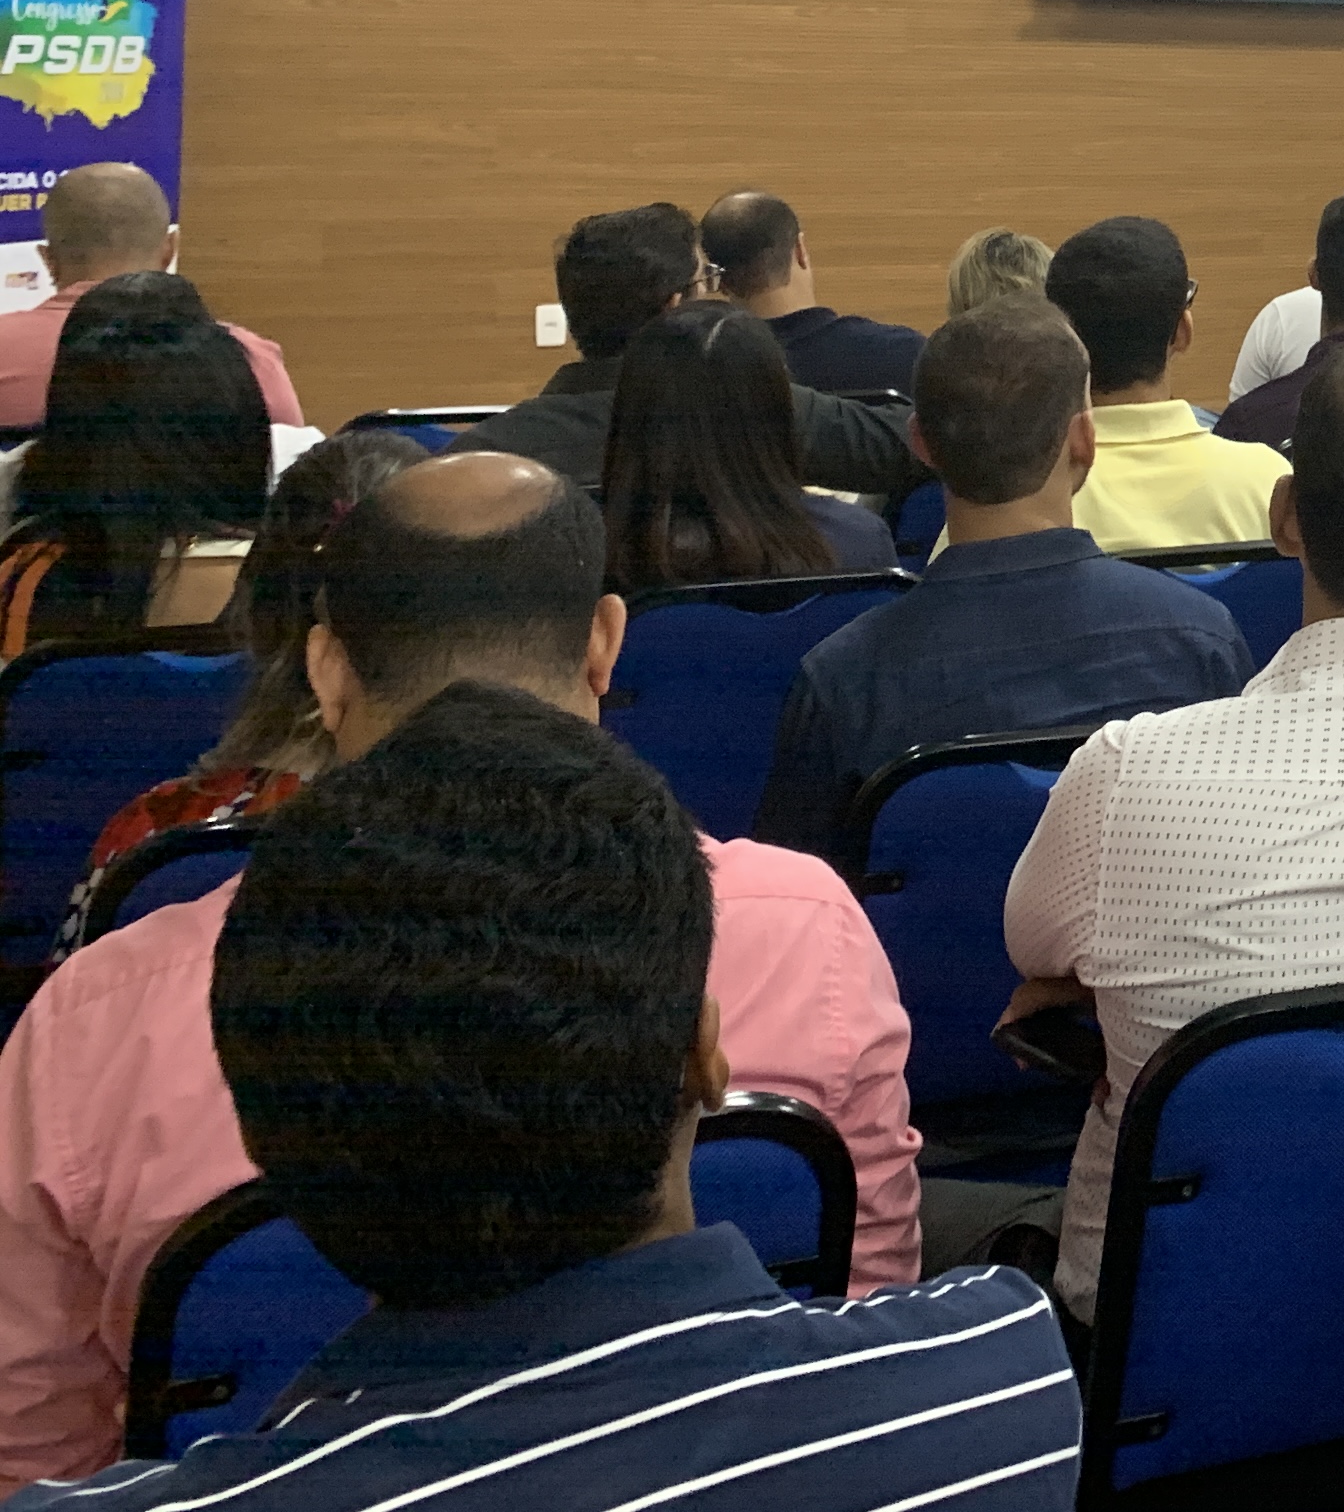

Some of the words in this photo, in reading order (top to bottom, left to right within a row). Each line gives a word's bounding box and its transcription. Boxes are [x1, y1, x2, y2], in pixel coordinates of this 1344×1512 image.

[0, 34, 146, 75] PSDB
[0, 170, 38, 190] CIDA
[42, 170, 57, 188] O
[0, 192, 32, 212] UER
